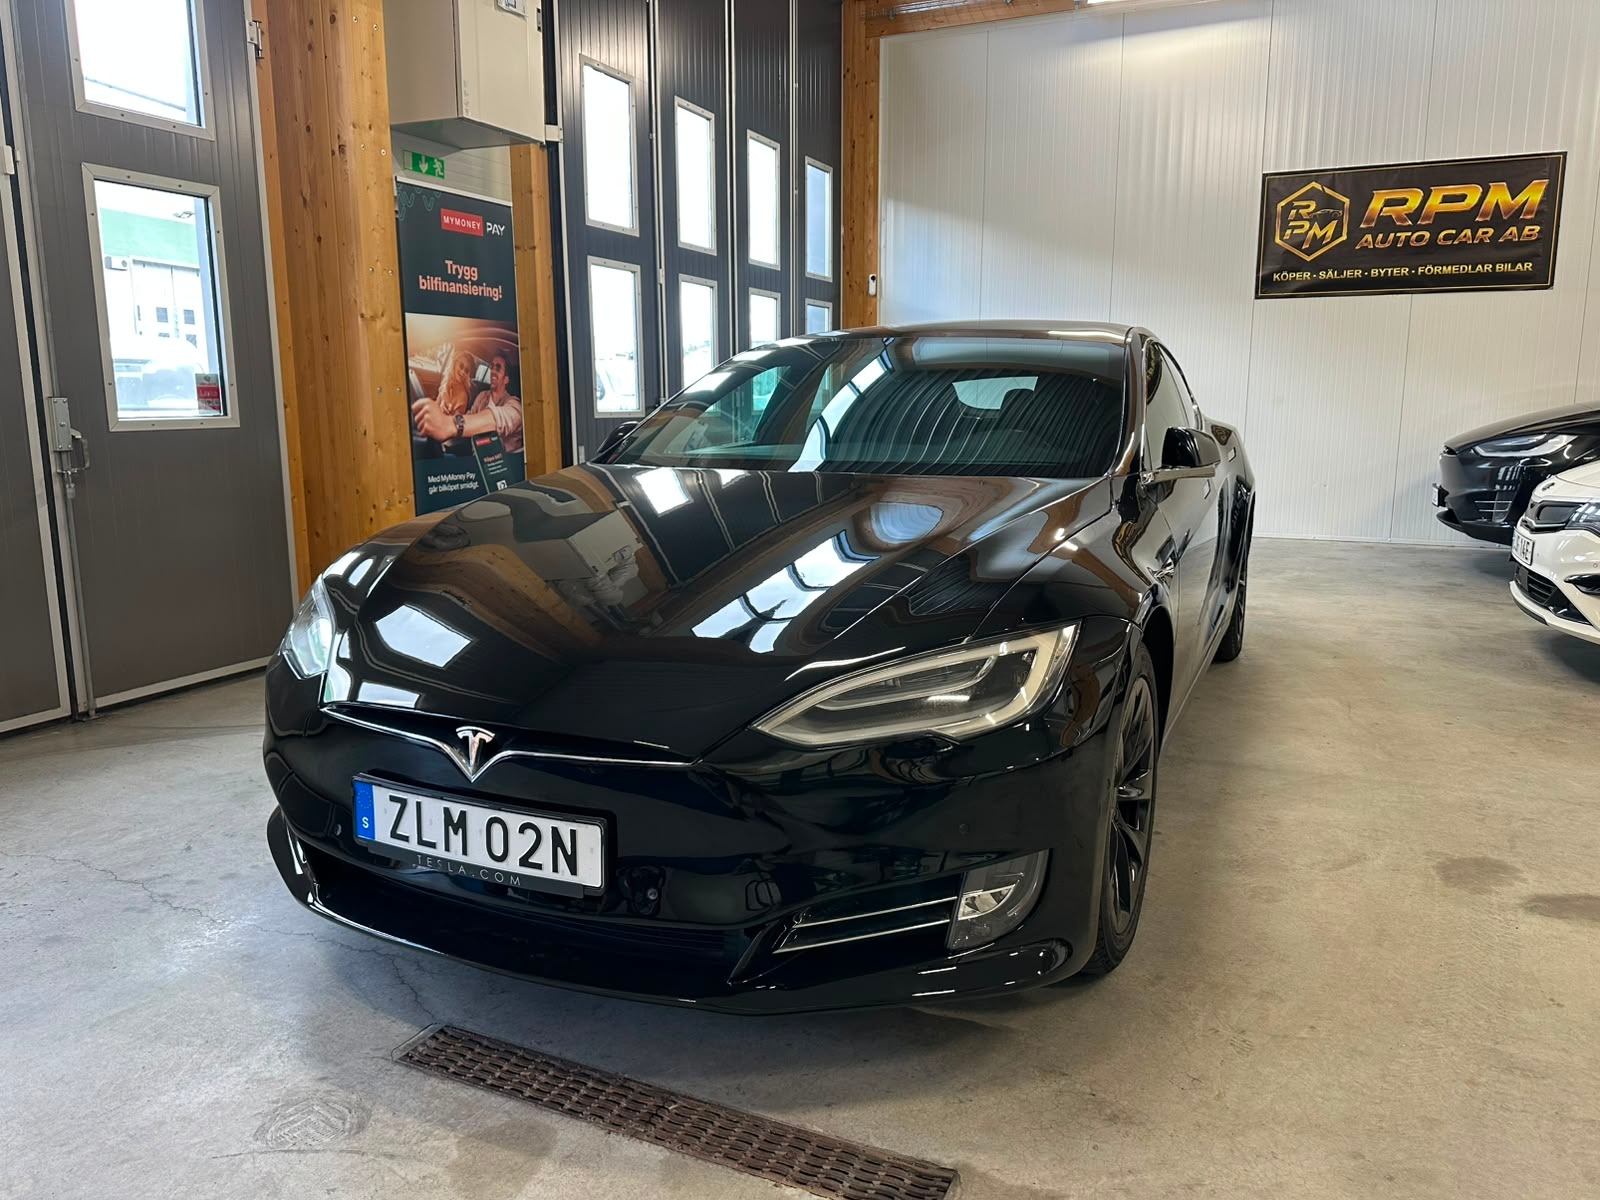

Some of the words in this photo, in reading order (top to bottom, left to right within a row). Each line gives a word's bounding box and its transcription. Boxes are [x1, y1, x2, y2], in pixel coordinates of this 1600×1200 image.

[1359, 178, 1550, 229] RPM
[443, 215, 481, 230] MYMONEY
[486, 222, 506, 236] PAY
[1355, 230, 1431, 250] AUTO
[1437, 227, 1494, 246] CAR
[1498, 224, 1541, 243] AB
[445, 260, 478, 281] Trygg
[1272, 270, 1311, 282] KÖPER
[1318, 268, 1362, 280] SÄLJER
[1370, 266, 1410, 278] BYTER
[1417, 263, 1493, 276] FÖRMEDLAR
[1495, 261, 1534, 273] BILAR
[418, 275, 503, 301] bilfinansiering!
[427, 474, 440, 483] Med
[440, 473, 466, 483] MyMoney
[466, 471, 476, 480] Pay
[428, 485, 438, 495] går
[438, 483, 460, 492] bilköpet
[361, 816, 370, 829] S
[388, 794, 468, 857] ZLM
[485, 815, 579, 877] 02N
[416, 854, 521, 886] TESLA.COM
